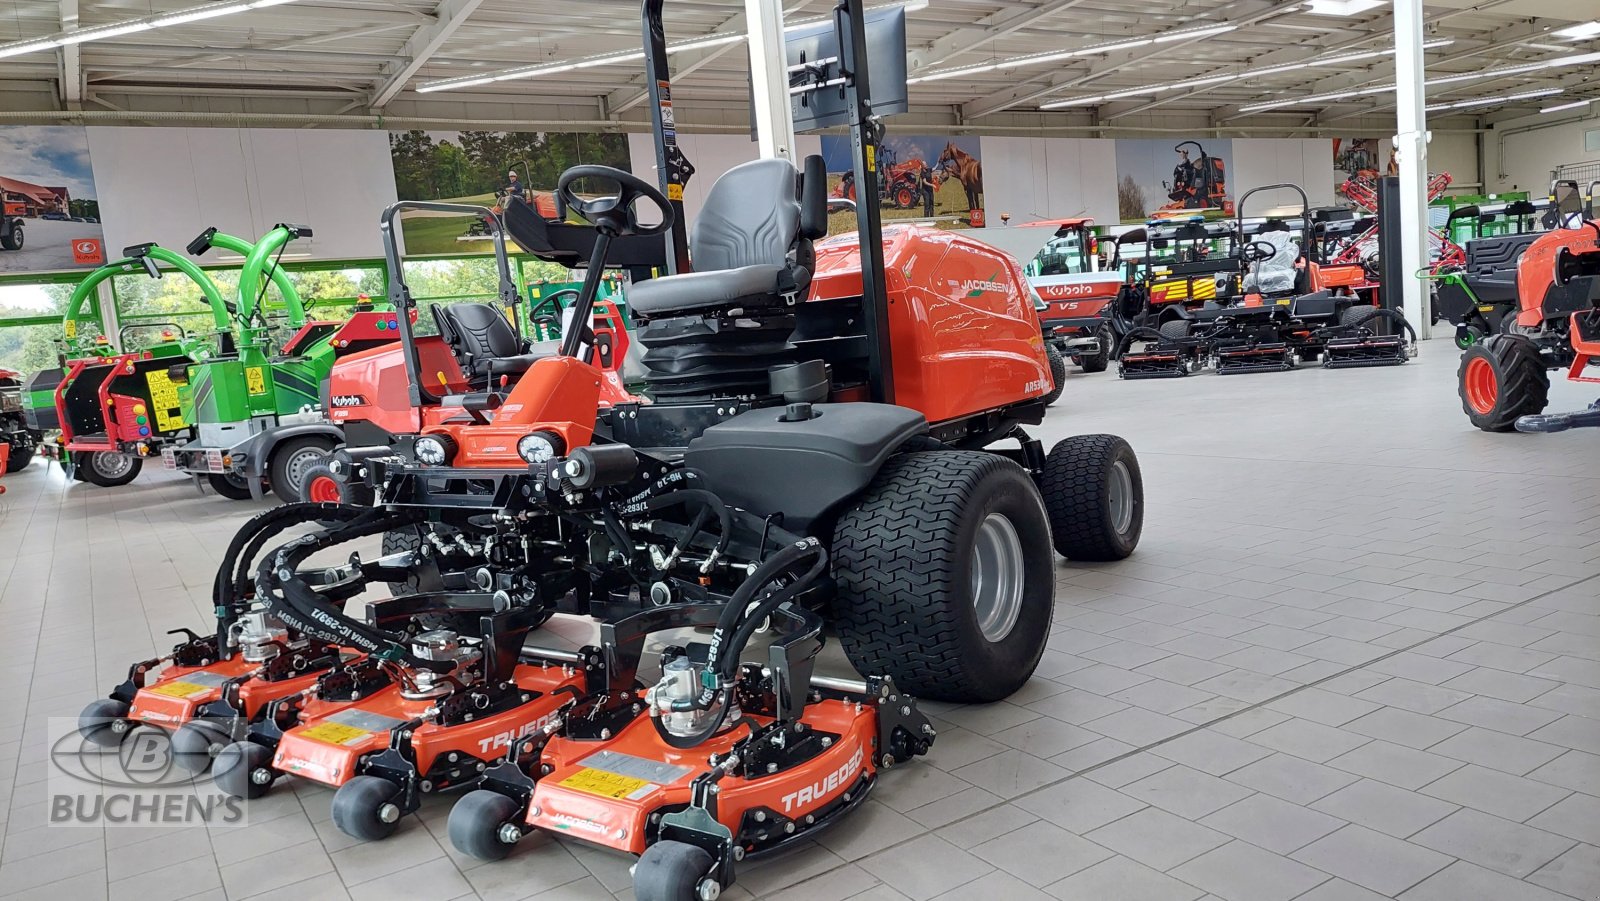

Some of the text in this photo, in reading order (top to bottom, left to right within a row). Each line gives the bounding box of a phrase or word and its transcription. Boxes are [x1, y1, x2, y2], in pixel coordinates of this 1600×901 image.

[961, 279, 1009, 294] JACOBSEN
[1046, 283, 1093, 296] Kubota
[332, 394, 361, 407] Kubota
[276, 609, 302, 631] MSHA
[310, 607, 379, 652] MSHA IC-293/1
